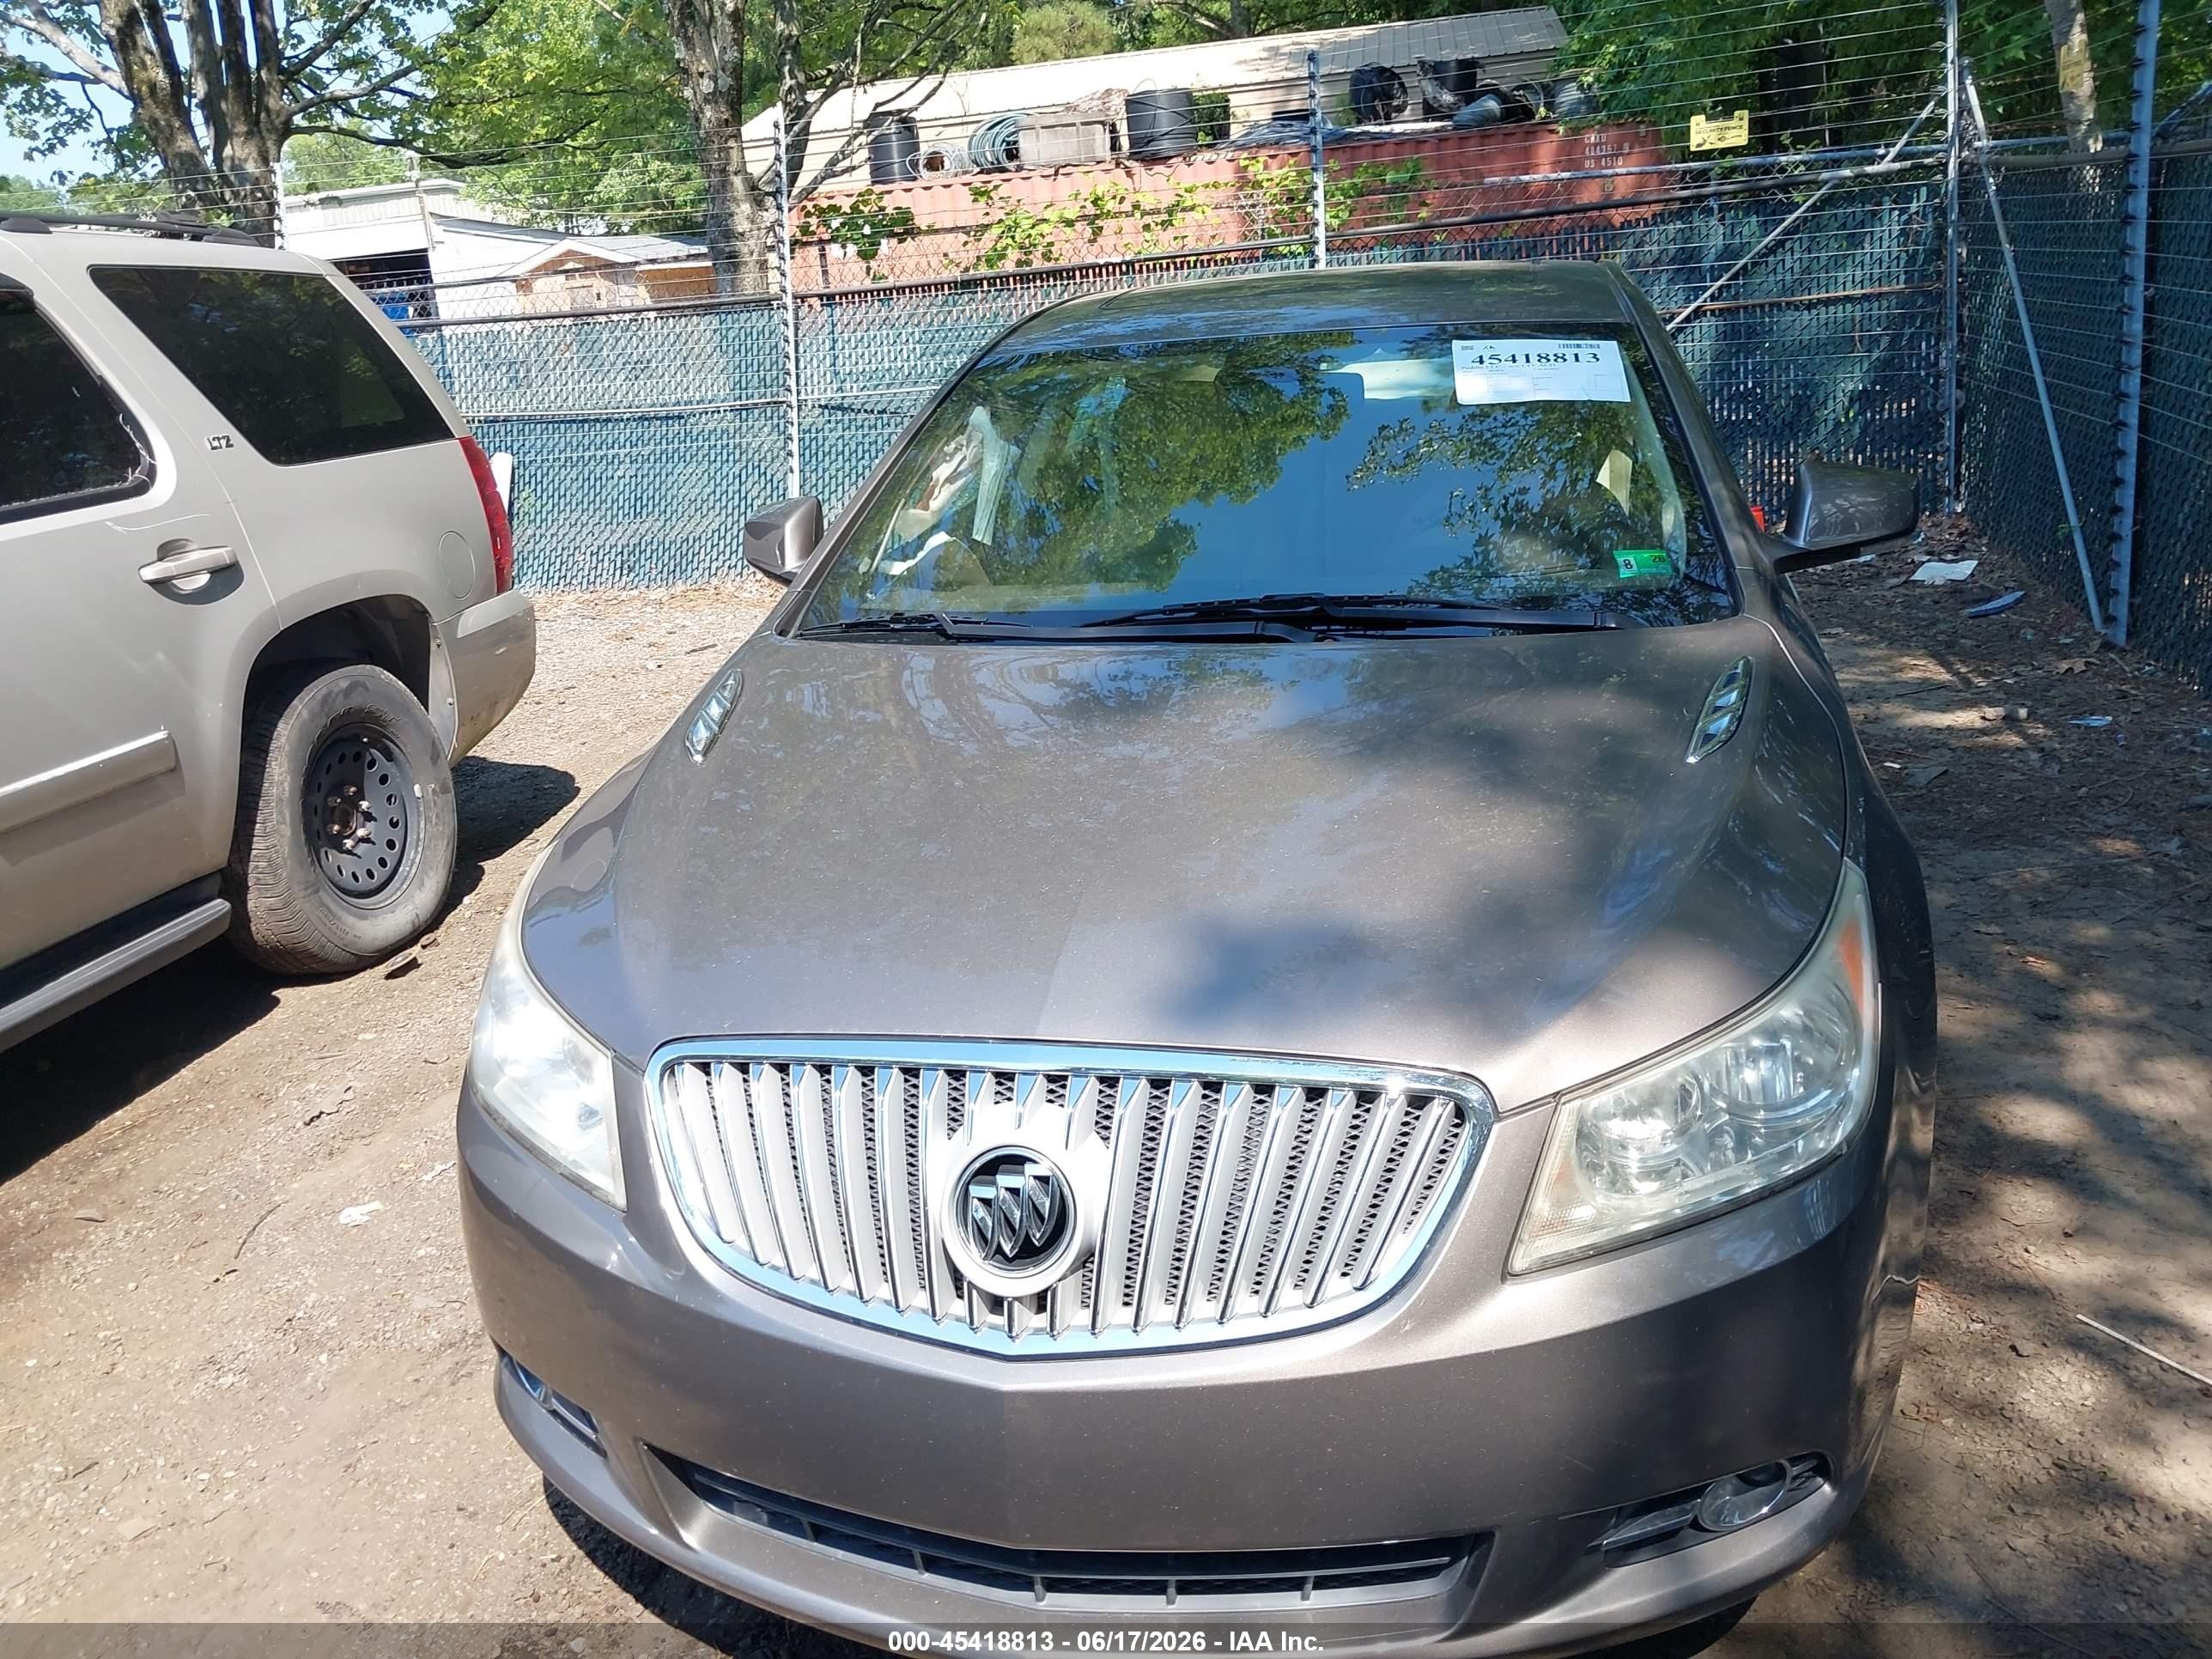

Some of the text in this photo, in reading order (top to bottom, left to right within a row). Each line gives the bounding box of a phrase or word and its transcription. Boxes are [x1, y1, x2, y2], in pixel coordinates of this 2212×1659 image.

[1601, 155, 1623, 167] 4510
[1470, 352, 1601, 365] 45418813
[206, 434, 234, 450] LTZ
[1623, 558, 1633, 569] 8
